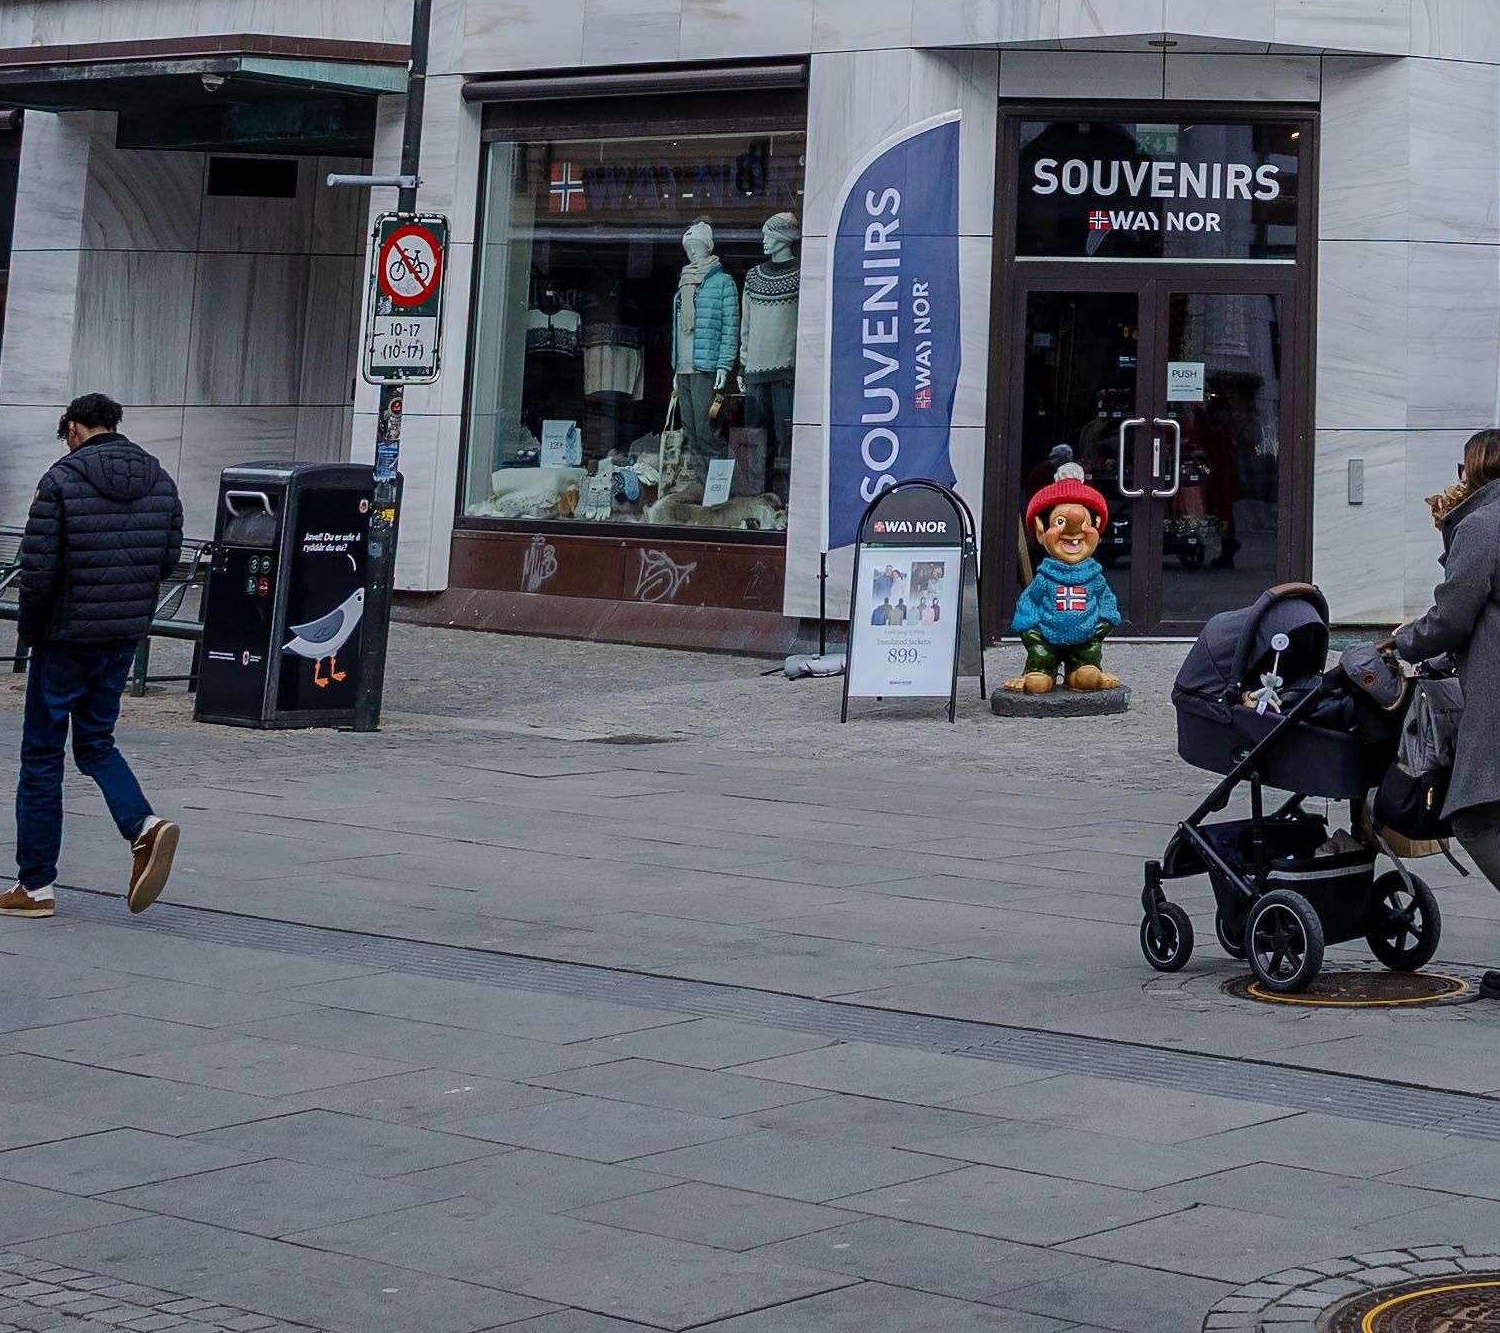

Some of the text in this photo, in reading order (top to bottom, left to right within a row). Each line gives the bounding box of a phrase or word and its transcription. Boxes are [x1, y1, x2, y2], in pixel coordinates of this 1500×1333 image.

[1031, 158, 1281, 201] SOUVENIRS
[1109, 210, 1222, 232] WAY NOR
[390, 322, 421, 337] 10-17
[912, 281, 933, 390] WAY NOR
[383, 344, 424, 360] (10-17)
[859, 186, 902, 506] SOUVENIRS
[1171, 369, 1197, 379] PUSH
[885, 521, 947, 533] WAY NOR
